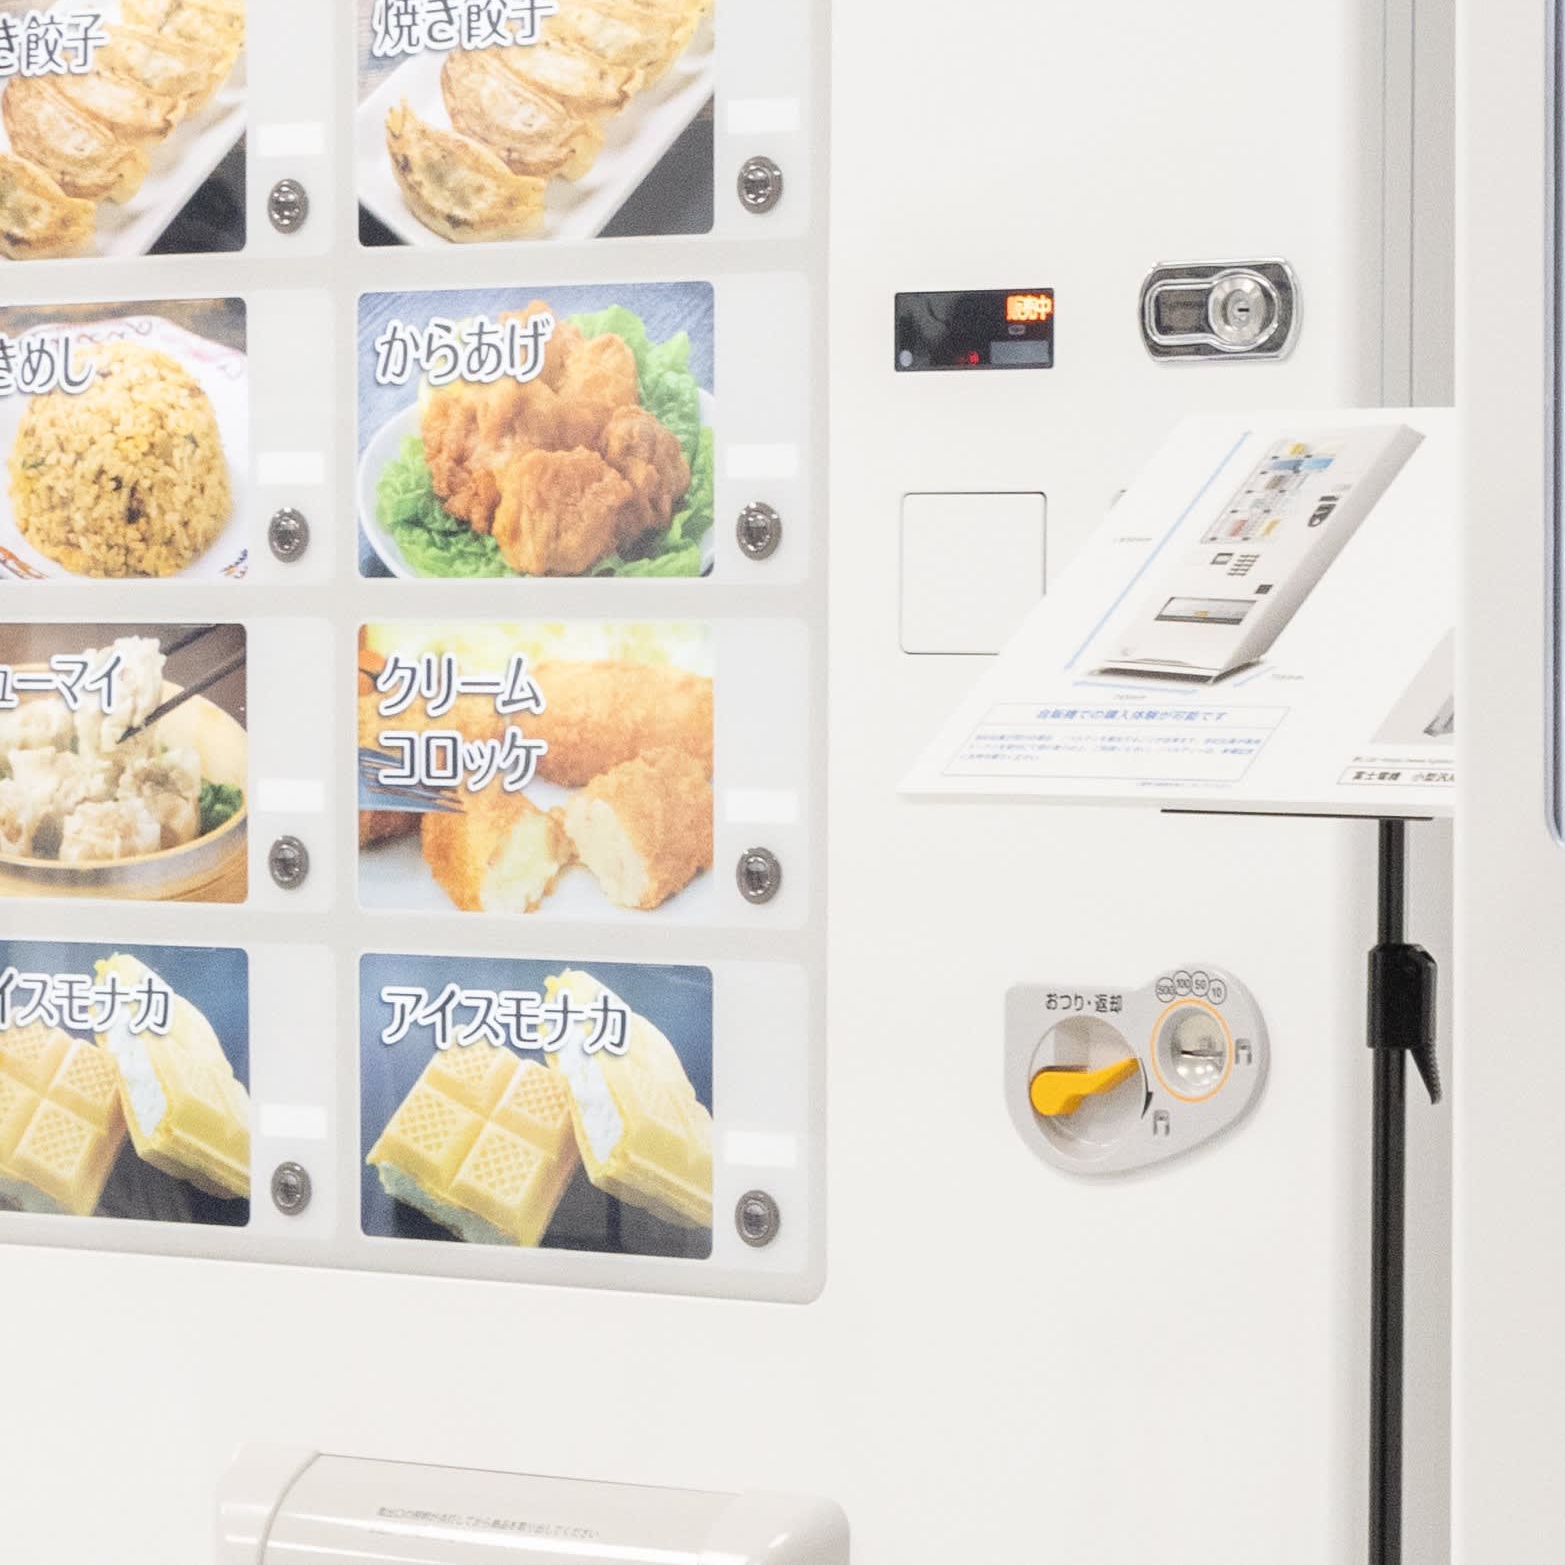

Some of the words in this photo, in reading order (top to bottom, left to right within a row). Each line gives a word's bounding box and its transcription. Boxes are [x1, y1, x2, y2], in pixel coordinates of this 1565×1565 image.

[376, 317, 555, 385] からあげ
[377, 654, 546, 716] クリーム
[378, 728, 547, 791] コロッケ
[380, 985, 631, 1055] アイスモナカ
[1045, 993, 1123, 1013] おつり・返却
